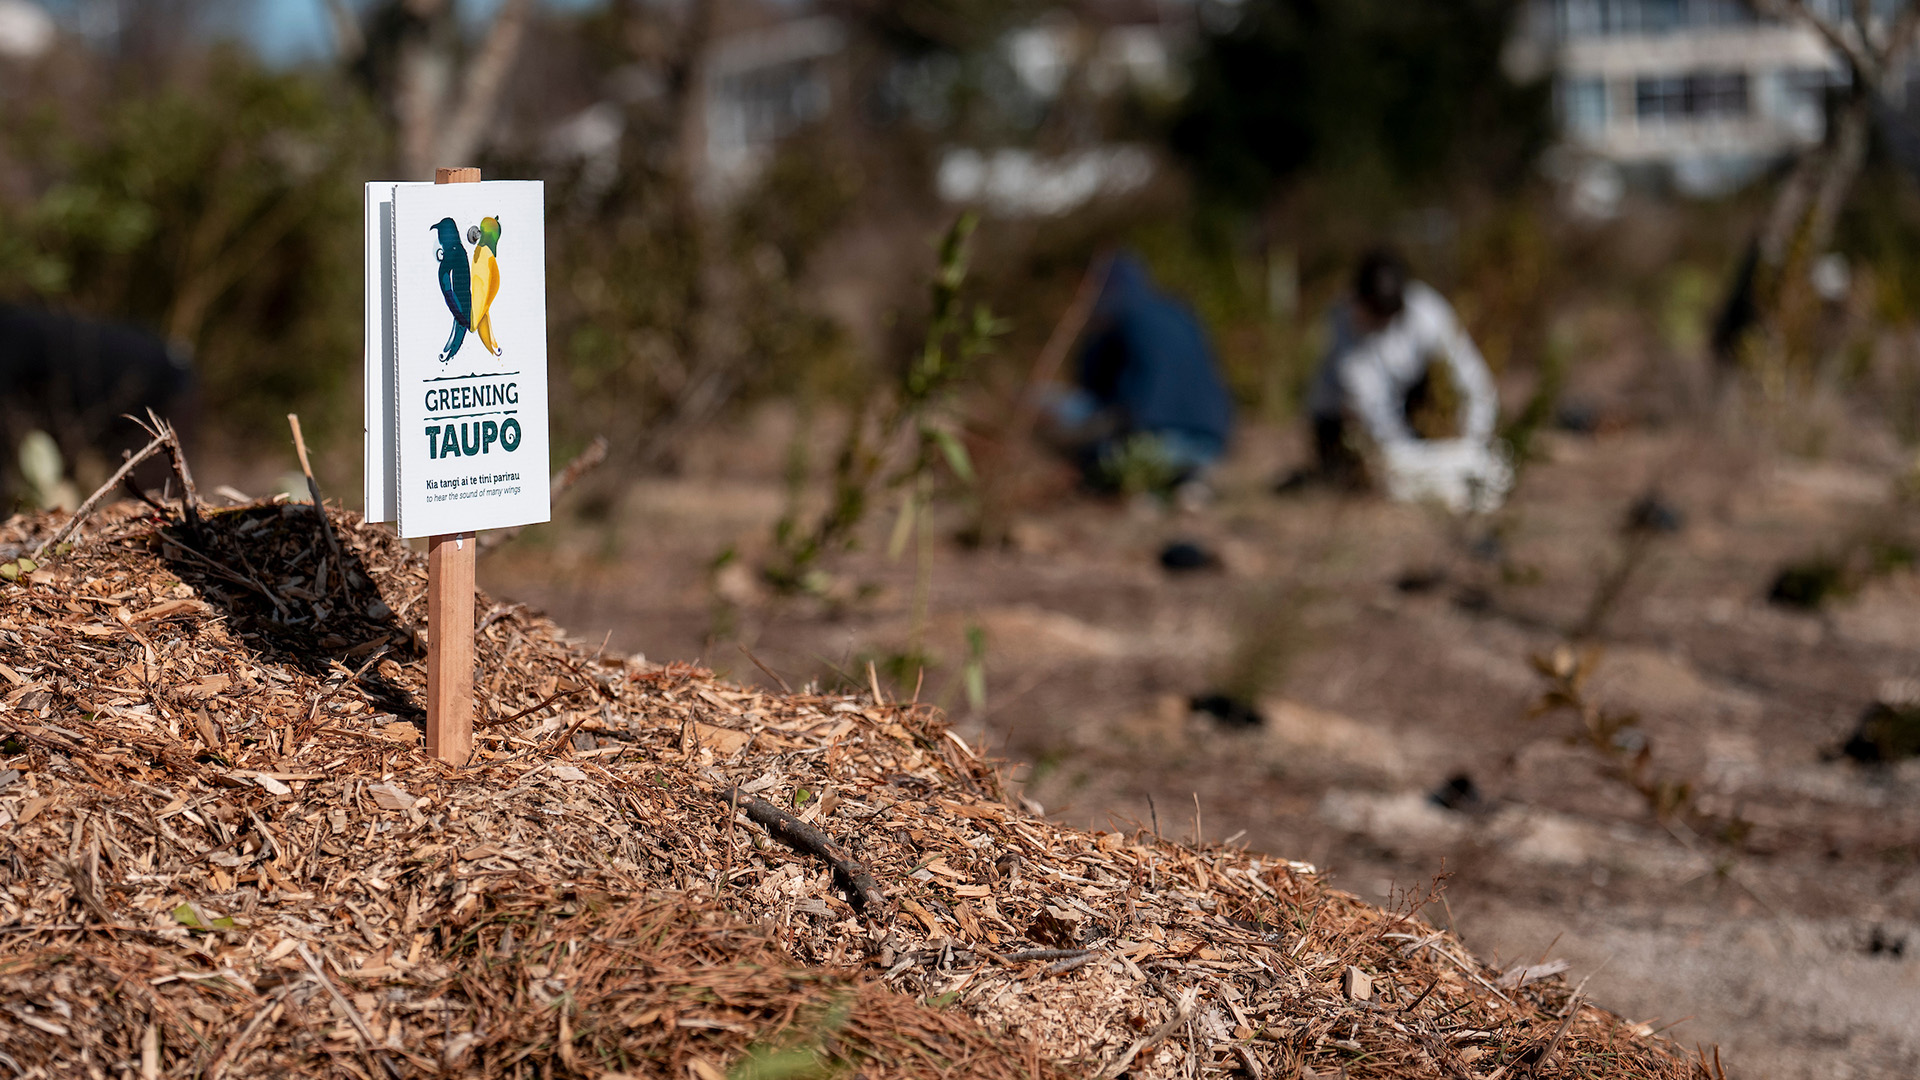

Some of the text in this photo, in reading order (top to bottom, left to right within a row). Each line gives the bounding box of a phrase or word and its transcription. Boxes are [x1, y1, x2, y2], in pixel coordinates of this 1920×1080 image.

[425, 382, 519, 412] GREENING
[426, 471, 520, 490] Kia tangi ai te tini parirau
[426, 485, 521, 503] to hear the sound of many wings
